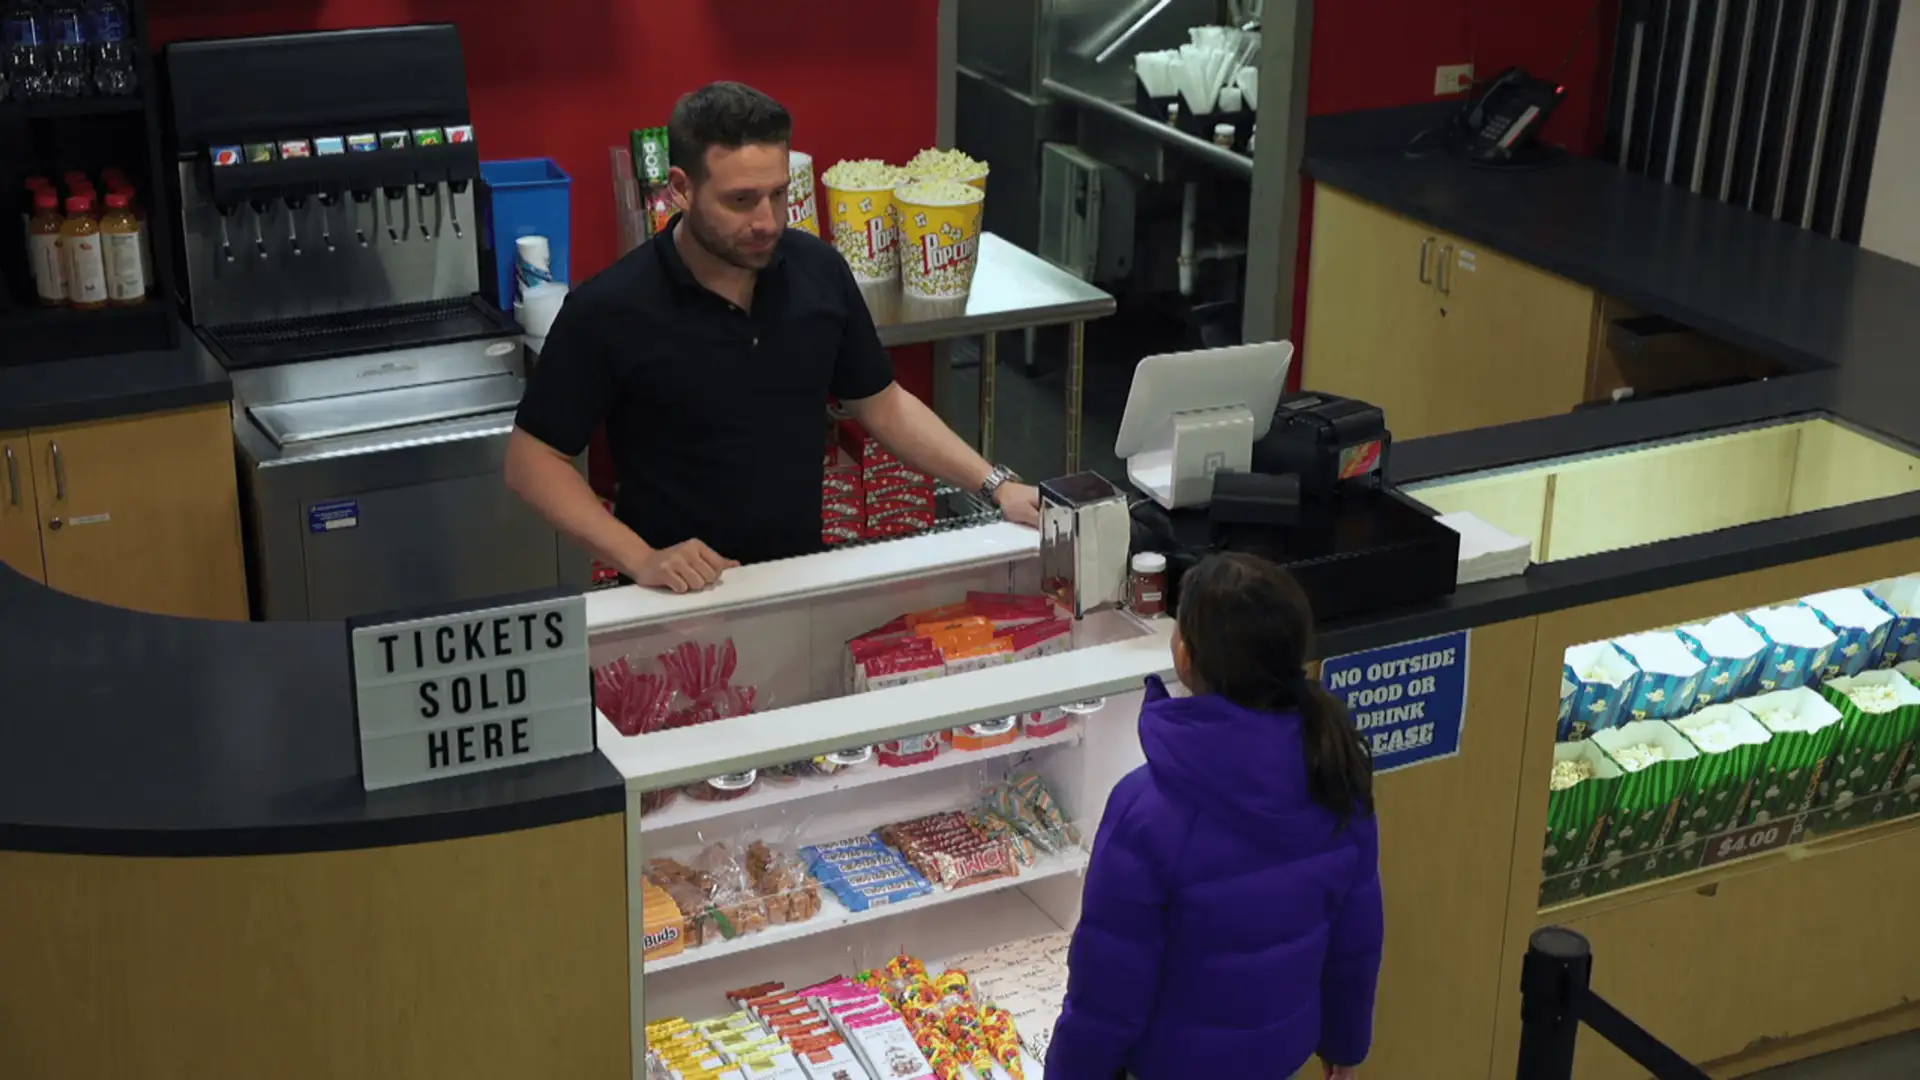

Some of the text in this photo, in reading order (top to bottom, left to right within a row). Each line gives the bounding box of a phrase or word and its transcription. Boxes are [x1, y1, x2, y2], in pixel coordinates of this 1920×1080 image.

[378, 611, 564, 673] TICKETS
[1330, 648, 1456, 691] NO OUTSIDE
[419, 668, 527, 718] SOLD
[1347, 675, 1436, 709] FOOD OR
[1356, 701, 1426, 731] DRINK
[428, 717, 530, 769] HERE
[1717, 827, 1779, 857] $4.00
